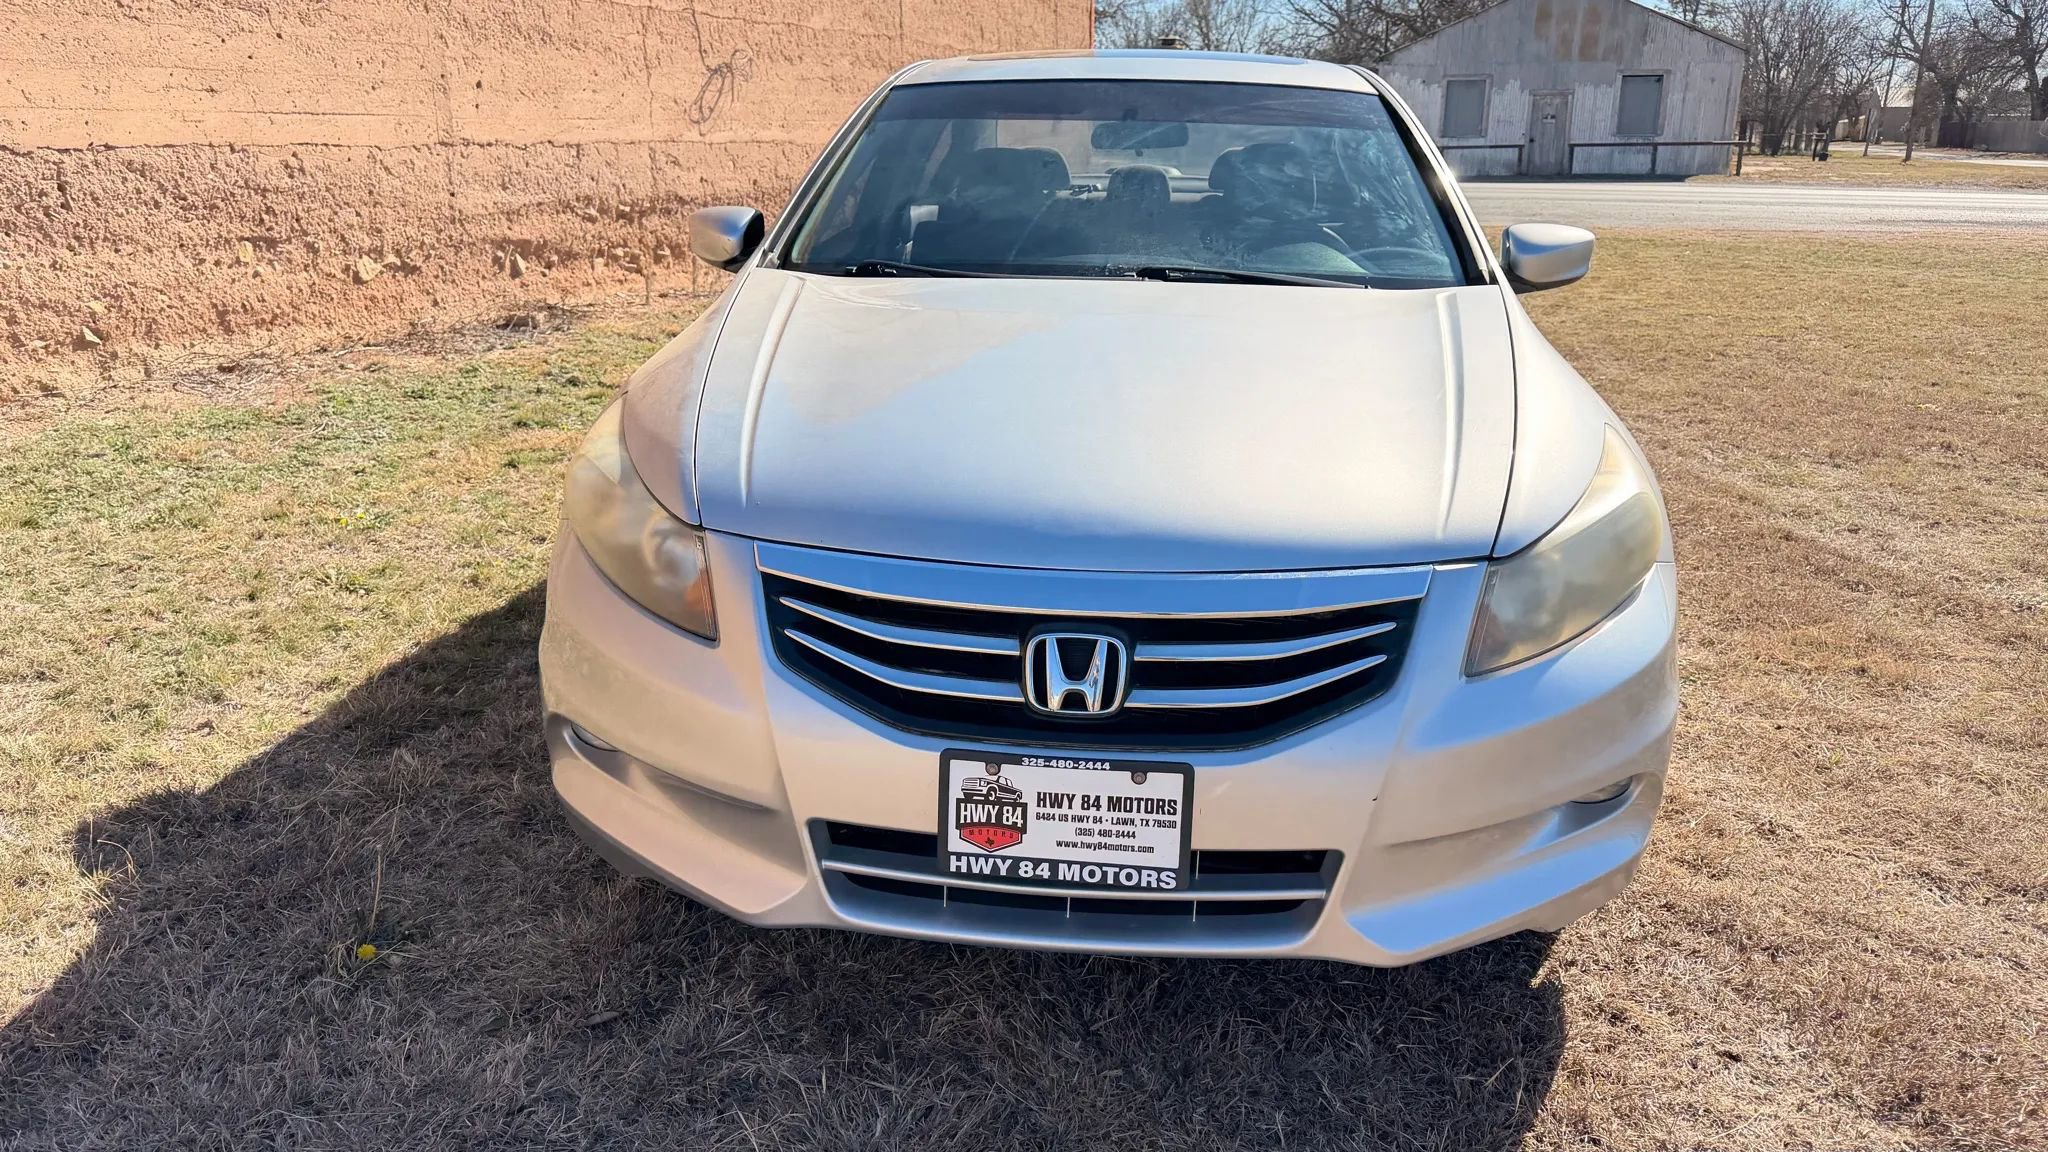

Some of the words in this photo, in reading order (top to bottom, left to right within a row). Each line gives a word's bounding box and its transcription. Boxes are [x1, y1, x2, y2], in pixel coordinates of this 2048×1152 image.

[1022, 758, 1110, 770] 325-480-2444
[1036, 792, 1076, 810] HWY
[1081, 795, 1102, 811] 84
[1107, 796, 1177, 815] MOTORS
[960, 803, 999, 824] HWY
[1003, 806, 1023, 827] 84
[1058, 814, 1069, 822] US
[1071, 815, 1090, 823] HWY
[1092, 816, 1103, 824] 84
[1111, 817, 1137, 827] LAWN,
[1140, 819, 1150, 827] TX
[1152, 820, 1177, 829] 79530
[1075, 828, 1095, 838] (325)
[1097, 829, 1136, 839] 480-2444
[1056, 840, 1154, 854] www.hwy84motors.com
[950, 855, 1013, 876] HWY
[1018, 861, 1051, 879] 84
[1058, 863, 1176, 889] MOTORS
